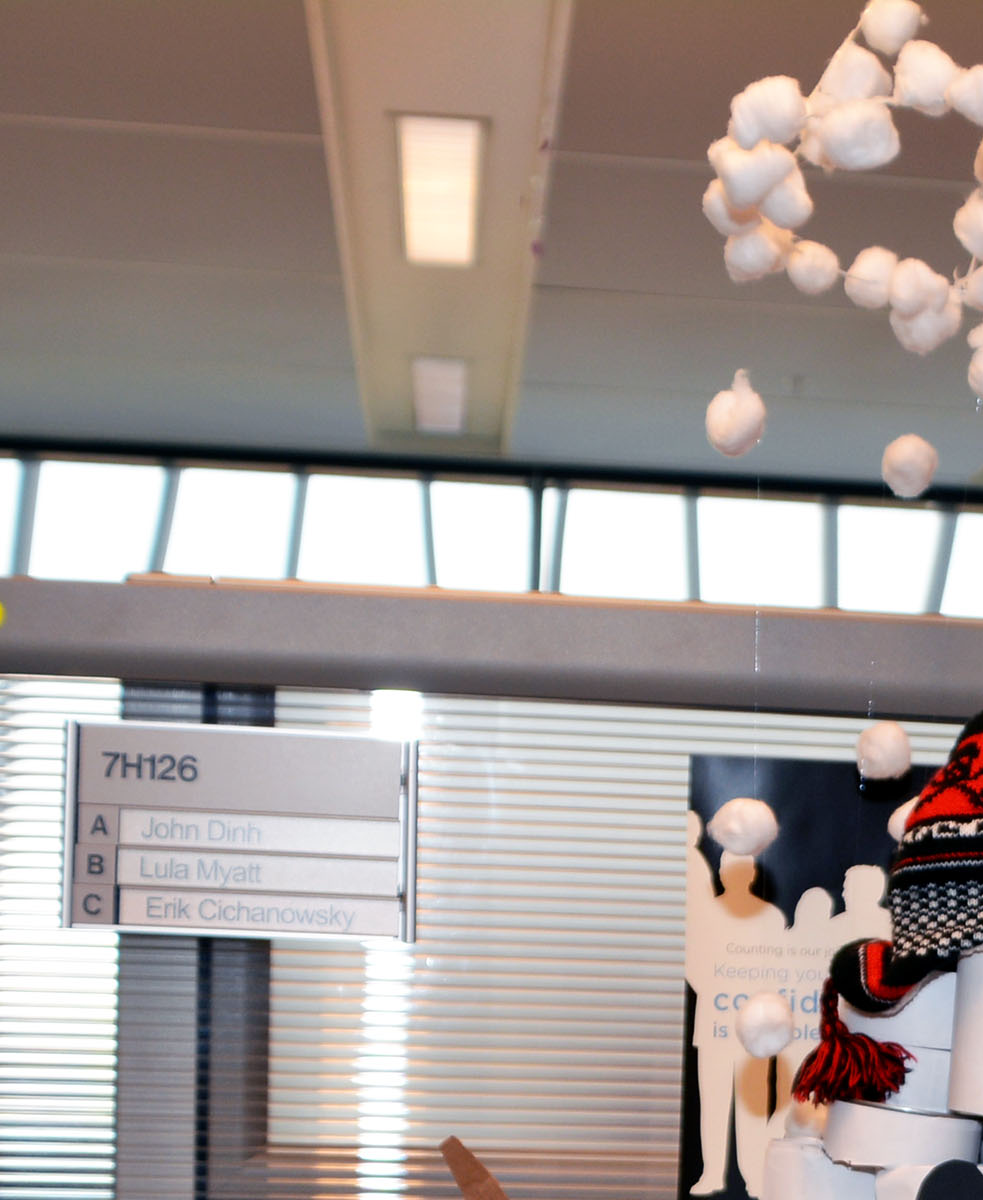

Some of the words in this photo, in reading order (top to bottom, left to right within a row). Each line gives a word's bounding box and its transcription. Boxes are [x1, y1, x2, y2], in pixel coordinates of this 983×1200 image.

[102, 751, 198, 782] 7H126
[90, 815, 108, 836] A
[141, 816, 199, 841] John
[208, 819, 262, 844] Dinh
[87, 855, 104, 875] B
[140, 856, 188, 880] Lula
[197, 858, 262, 889] Myatt
[83, 893, 101, 915] C
[146, 896, 190, 920] Erik
[198, 898, 356, 930] Cichanowsky
[726, 942, 783, 957] Counting
[787, 947, 797, 955] is
[800, 948, 821, 956] our
[714, 962, 788, 982] Keeping
[713, 1022, 728, 1038] is
